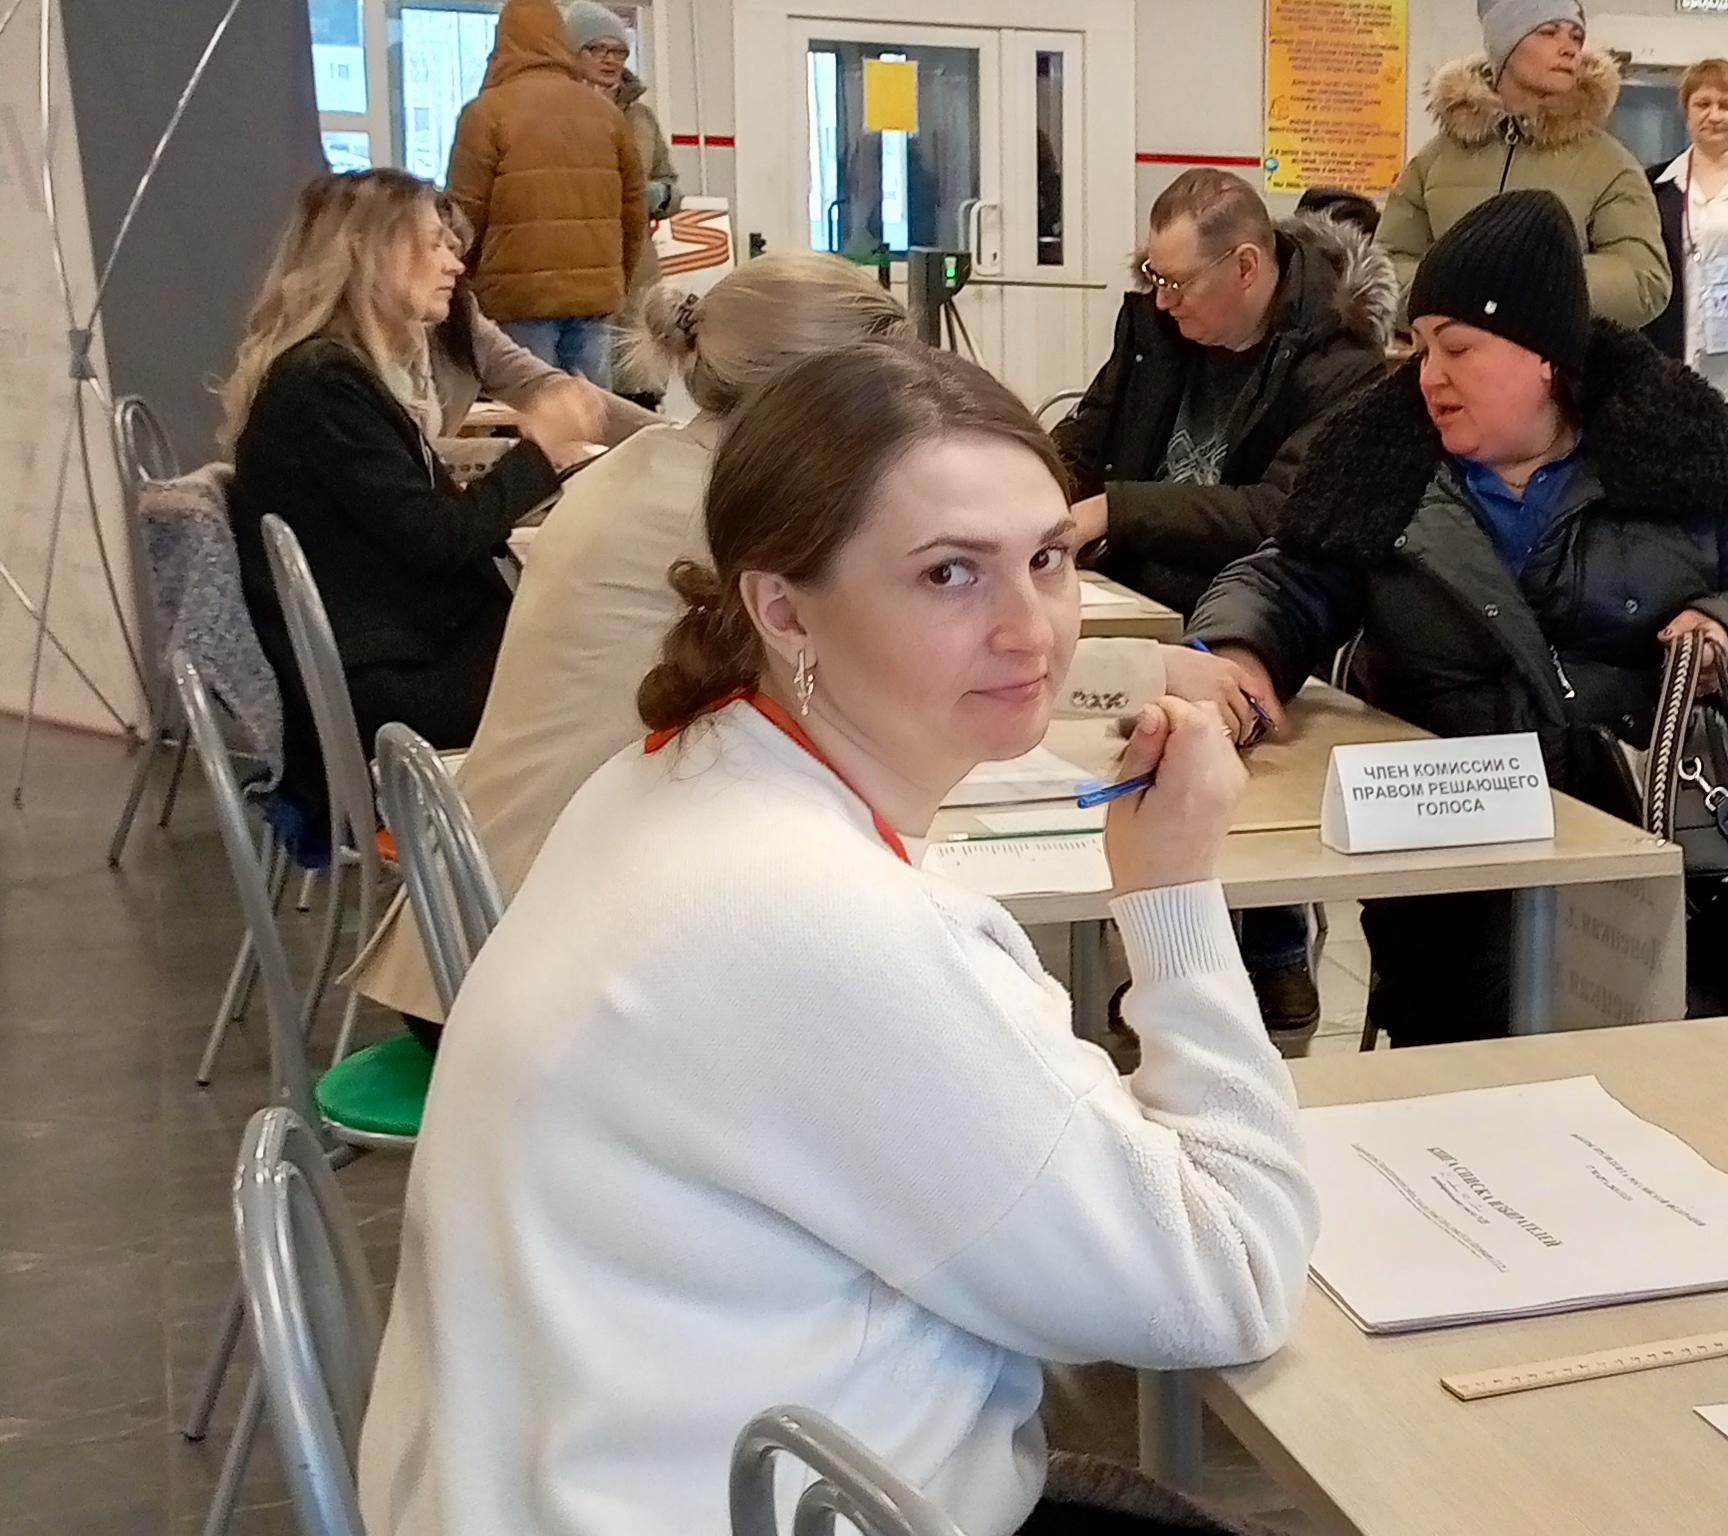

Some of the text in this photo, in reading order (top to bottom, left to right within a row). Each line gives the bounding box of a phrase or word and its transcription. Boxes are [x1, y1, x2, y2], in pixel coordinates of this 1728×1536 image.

[1363, 757, 1520, 781] ЧЛЕН КОМИССИИ С
[1352, 774, 1539, 801] ПРАВОМ РЕШАЮЩЕГО
[1417, 798, 1485, 817] ГОЛОСА
